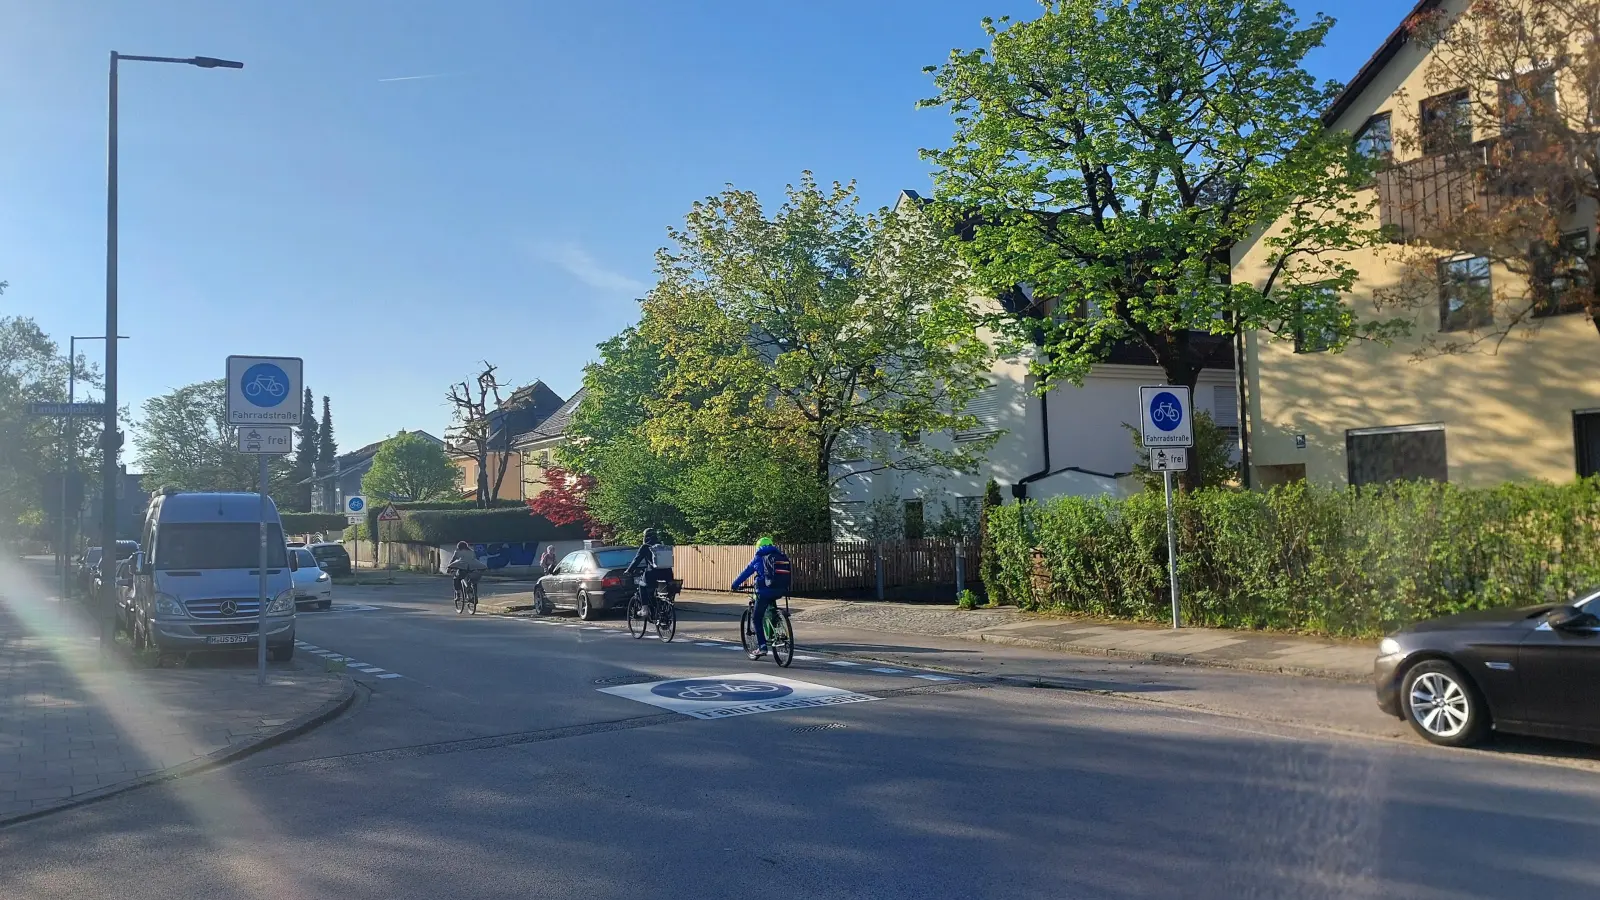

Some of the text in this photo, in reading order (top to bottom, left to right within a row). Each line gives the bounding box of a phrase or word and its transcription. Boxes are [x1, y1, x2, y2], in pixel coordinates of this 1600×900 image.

[232, 411, 297, 420] Fahrradstraße
[268, 436, 287, 445] frei
[1170, 454, 1184, 463] frei
